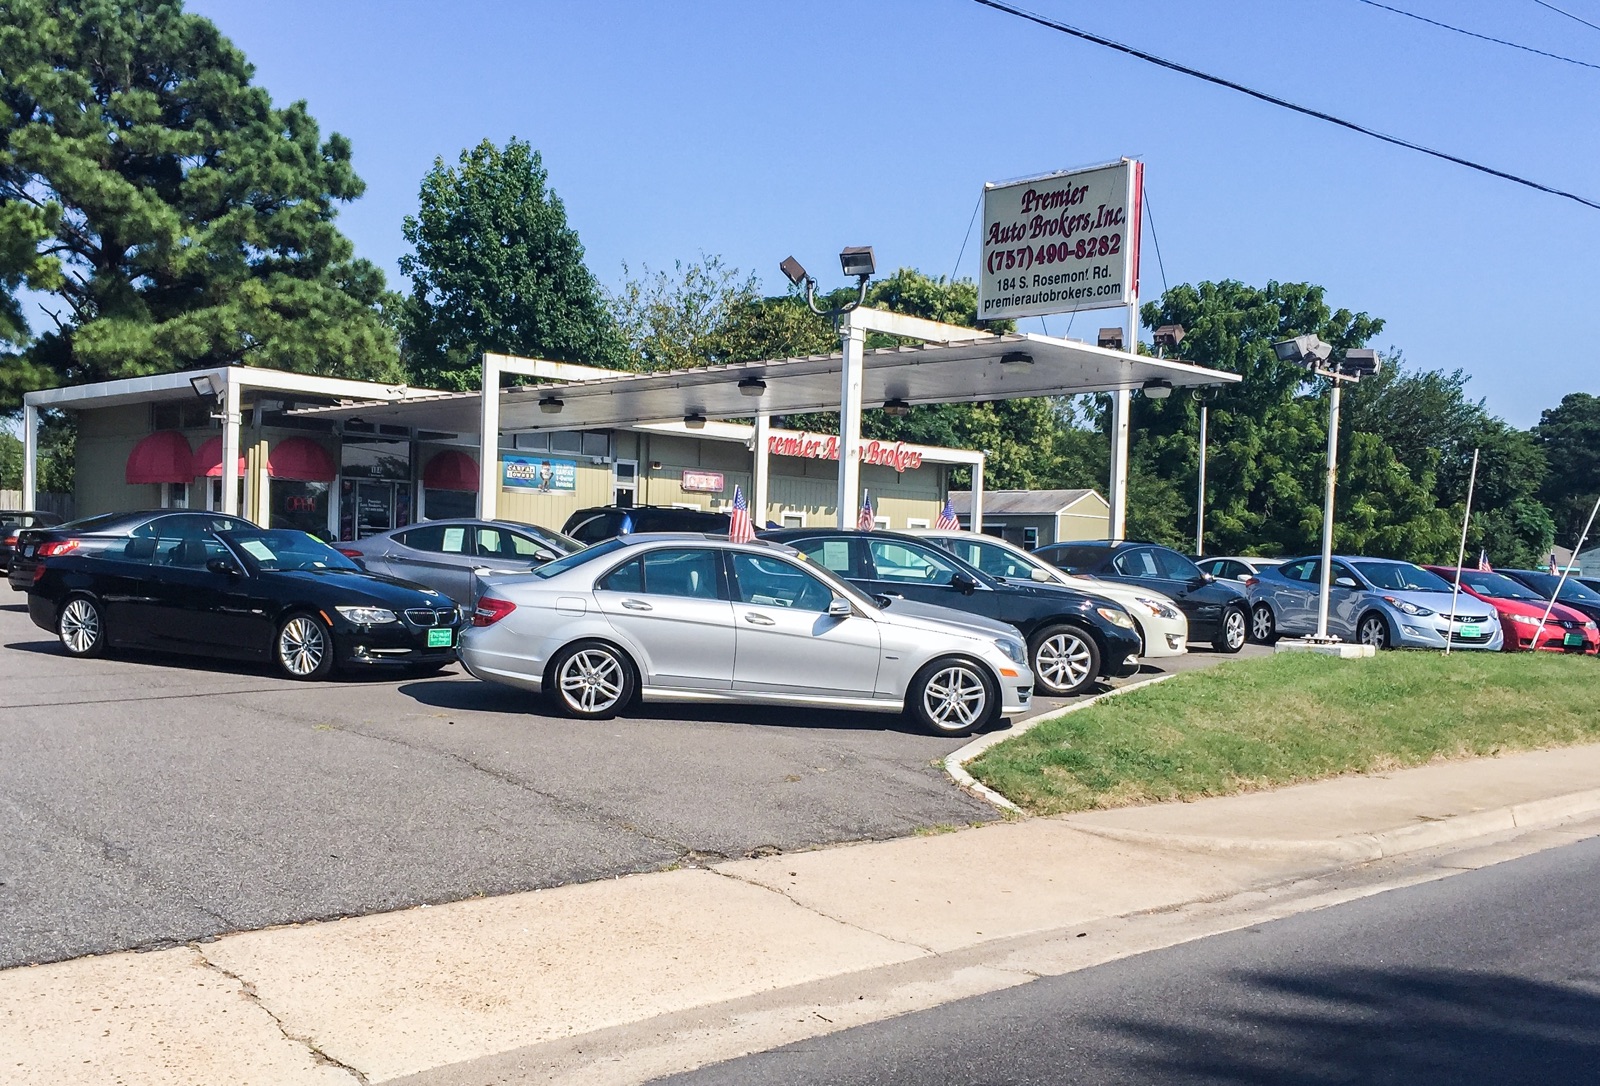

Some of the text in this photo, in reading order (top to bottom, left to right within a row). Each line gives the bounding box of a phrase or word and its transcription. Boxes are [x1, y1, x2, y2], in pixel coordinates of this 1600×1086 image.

[1020, 181, 1089, 214] Premier
[985, 221, 1027, 246] Auto
[997, 278, 1016, 292] 184
[1019, 277, 1029, 289] S.
[1093, 265, 1112, 280] Rd.
[984, 283, 1121, 312] premierautobrokers.com
[768, 432, 821, 459] remier
[868, 440, 923, 473] Brokers
